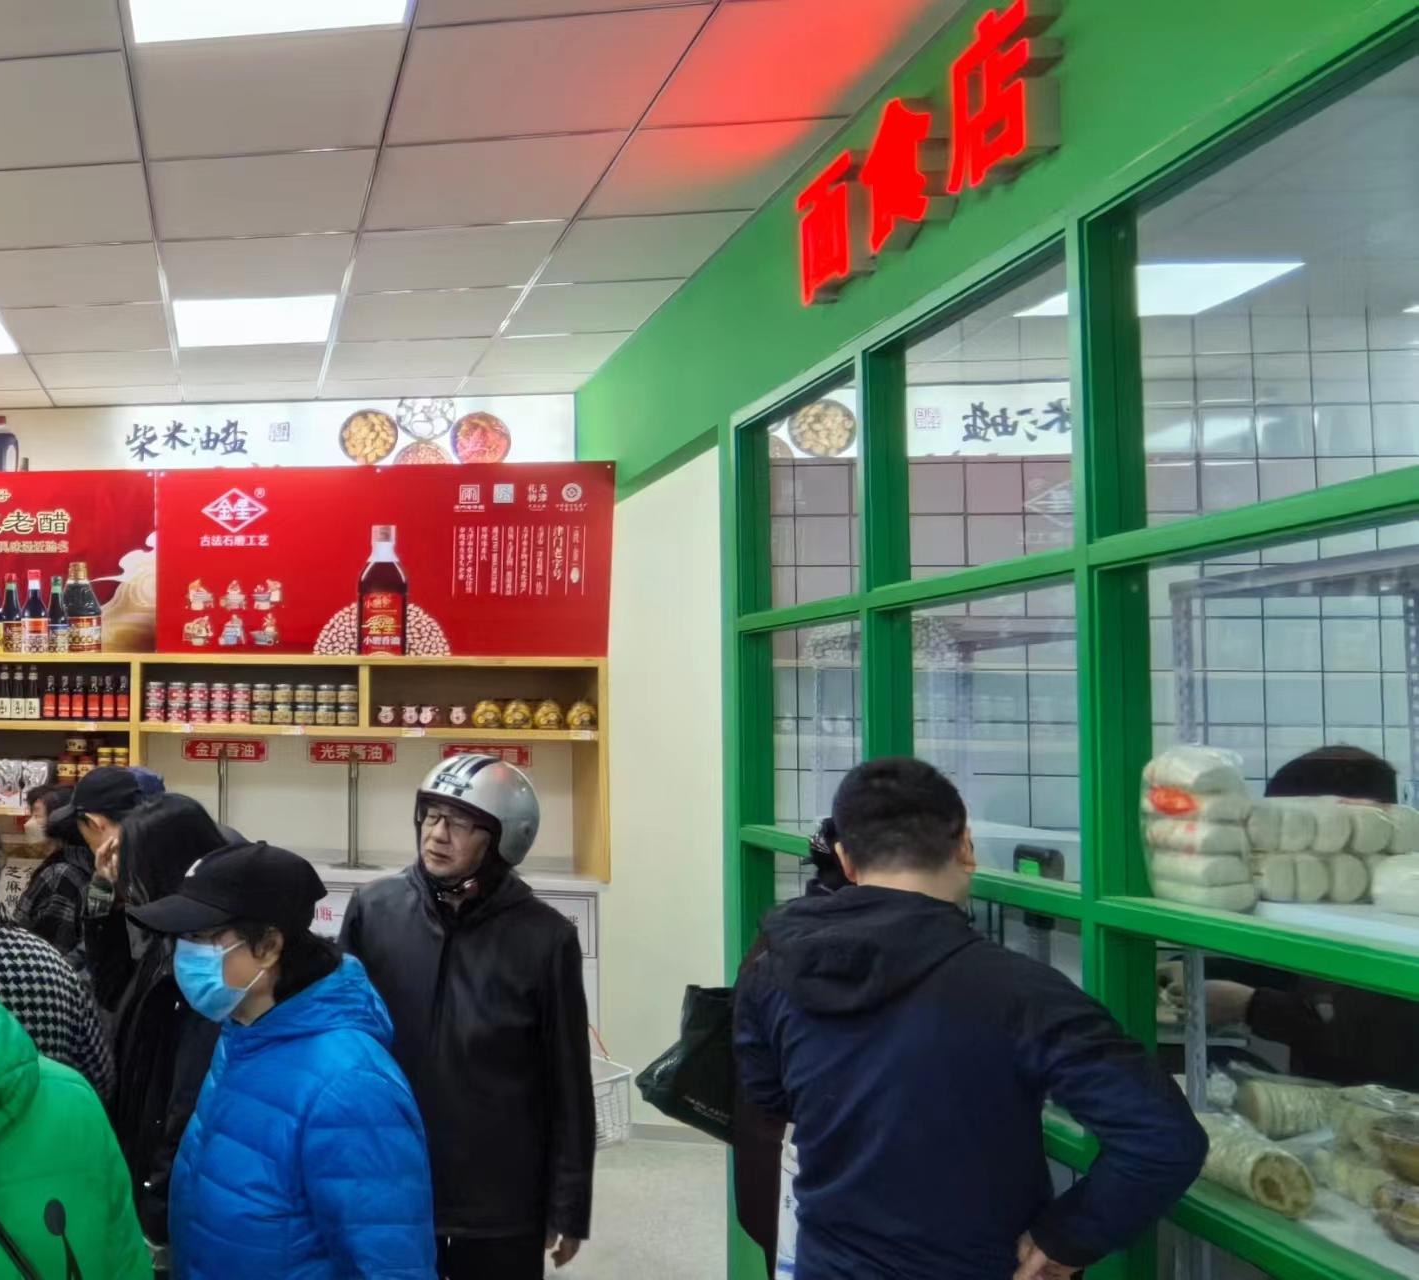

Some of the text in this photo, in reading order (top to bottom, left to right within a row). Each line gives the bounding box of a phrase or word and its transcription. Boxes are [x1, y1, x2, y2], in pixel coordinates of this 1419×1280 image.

[795, 0, 1029, 307] 面食店
[125, 419, 248, 462] 柴米油盐
[199, 534, 269, 547] 古法石磨工艺
[195, 742, 255, 758] 金星香油
[320, 744, 383, 760] 光荣酱油
